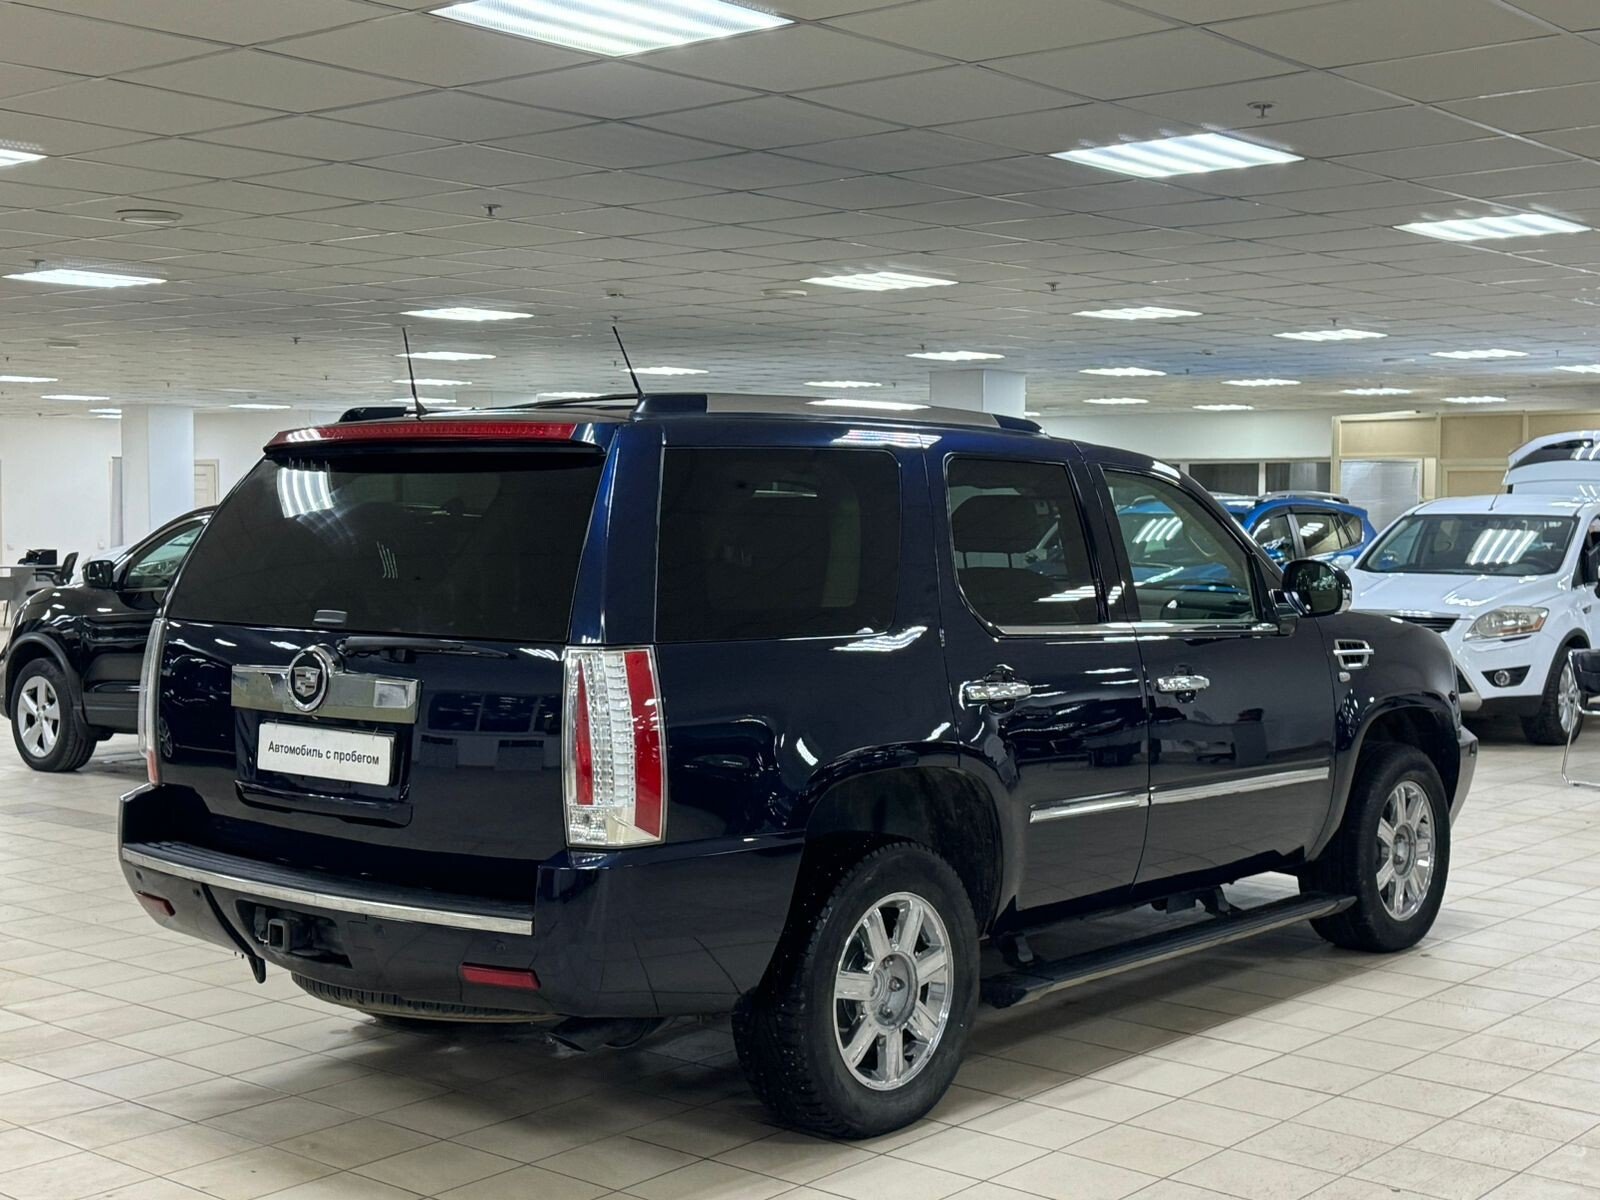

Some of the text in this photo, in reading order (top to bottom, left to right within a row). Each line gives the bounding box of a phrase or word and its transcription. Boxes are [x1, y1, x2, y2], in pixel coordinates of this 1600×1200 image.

[268, 741, 379, 765] Автомобиль с пробегом
